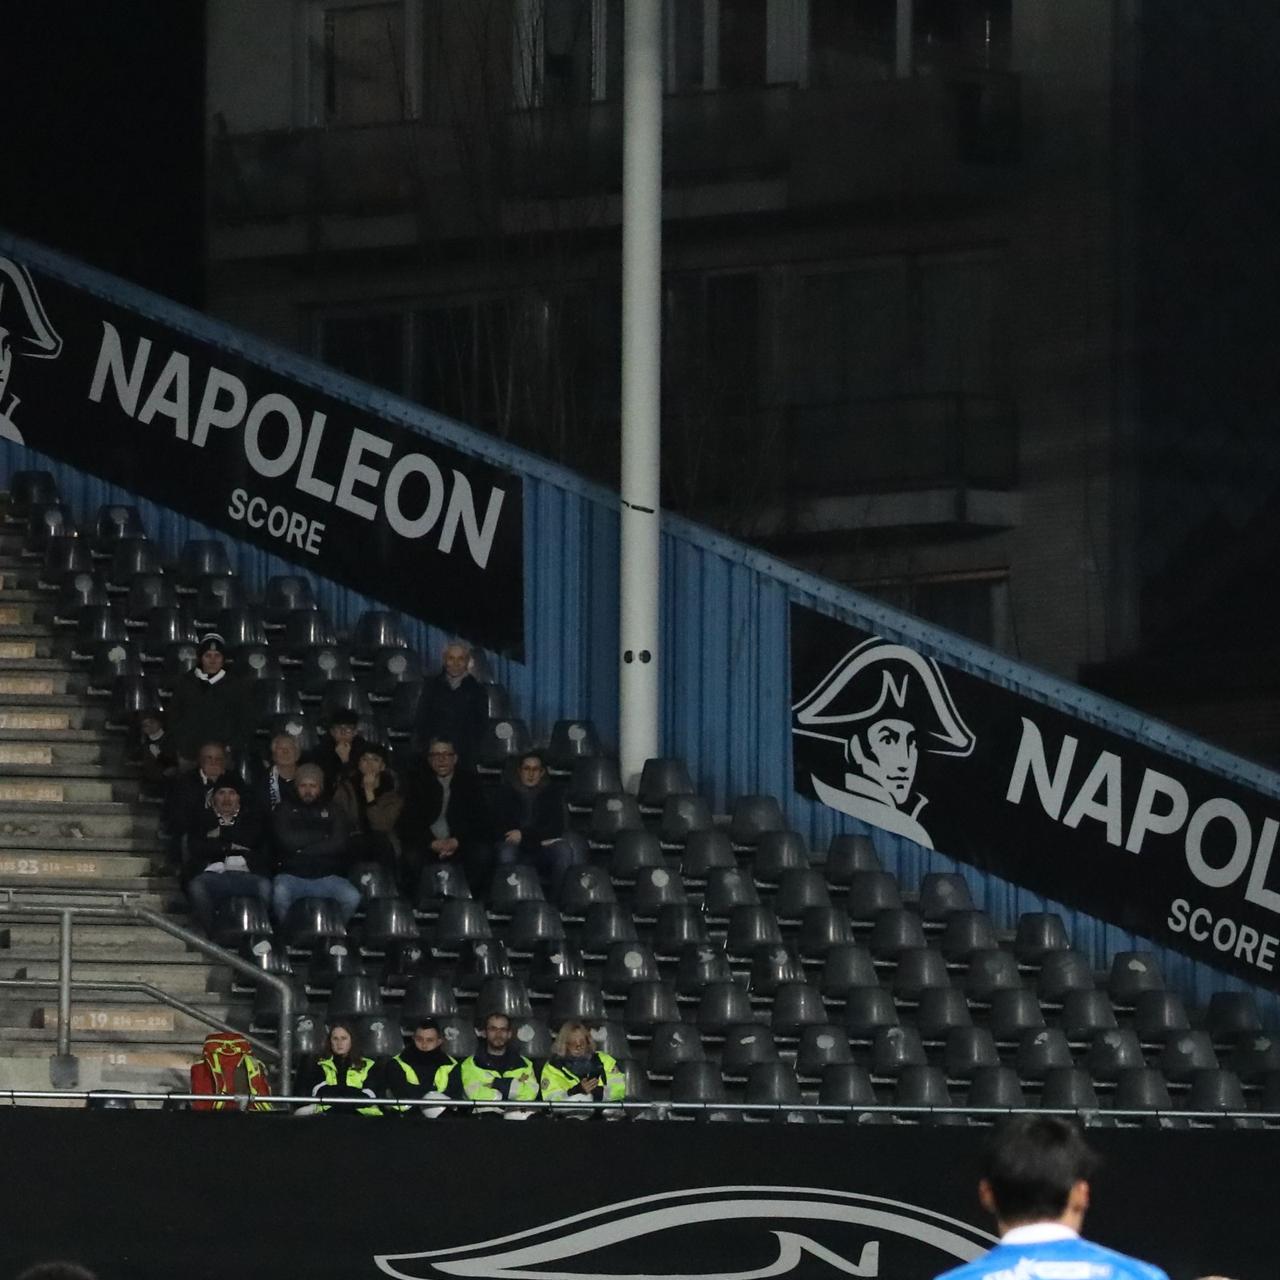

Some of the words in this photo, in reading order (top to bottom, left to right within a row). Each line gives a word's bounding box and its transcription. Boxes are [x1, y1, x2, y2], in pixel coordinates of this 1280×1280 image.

[89, 321, 504, 569] NAPOLEON
[228, 487, 326, 555] SCORE
[1167, 899, 1280, 973] SCORE
